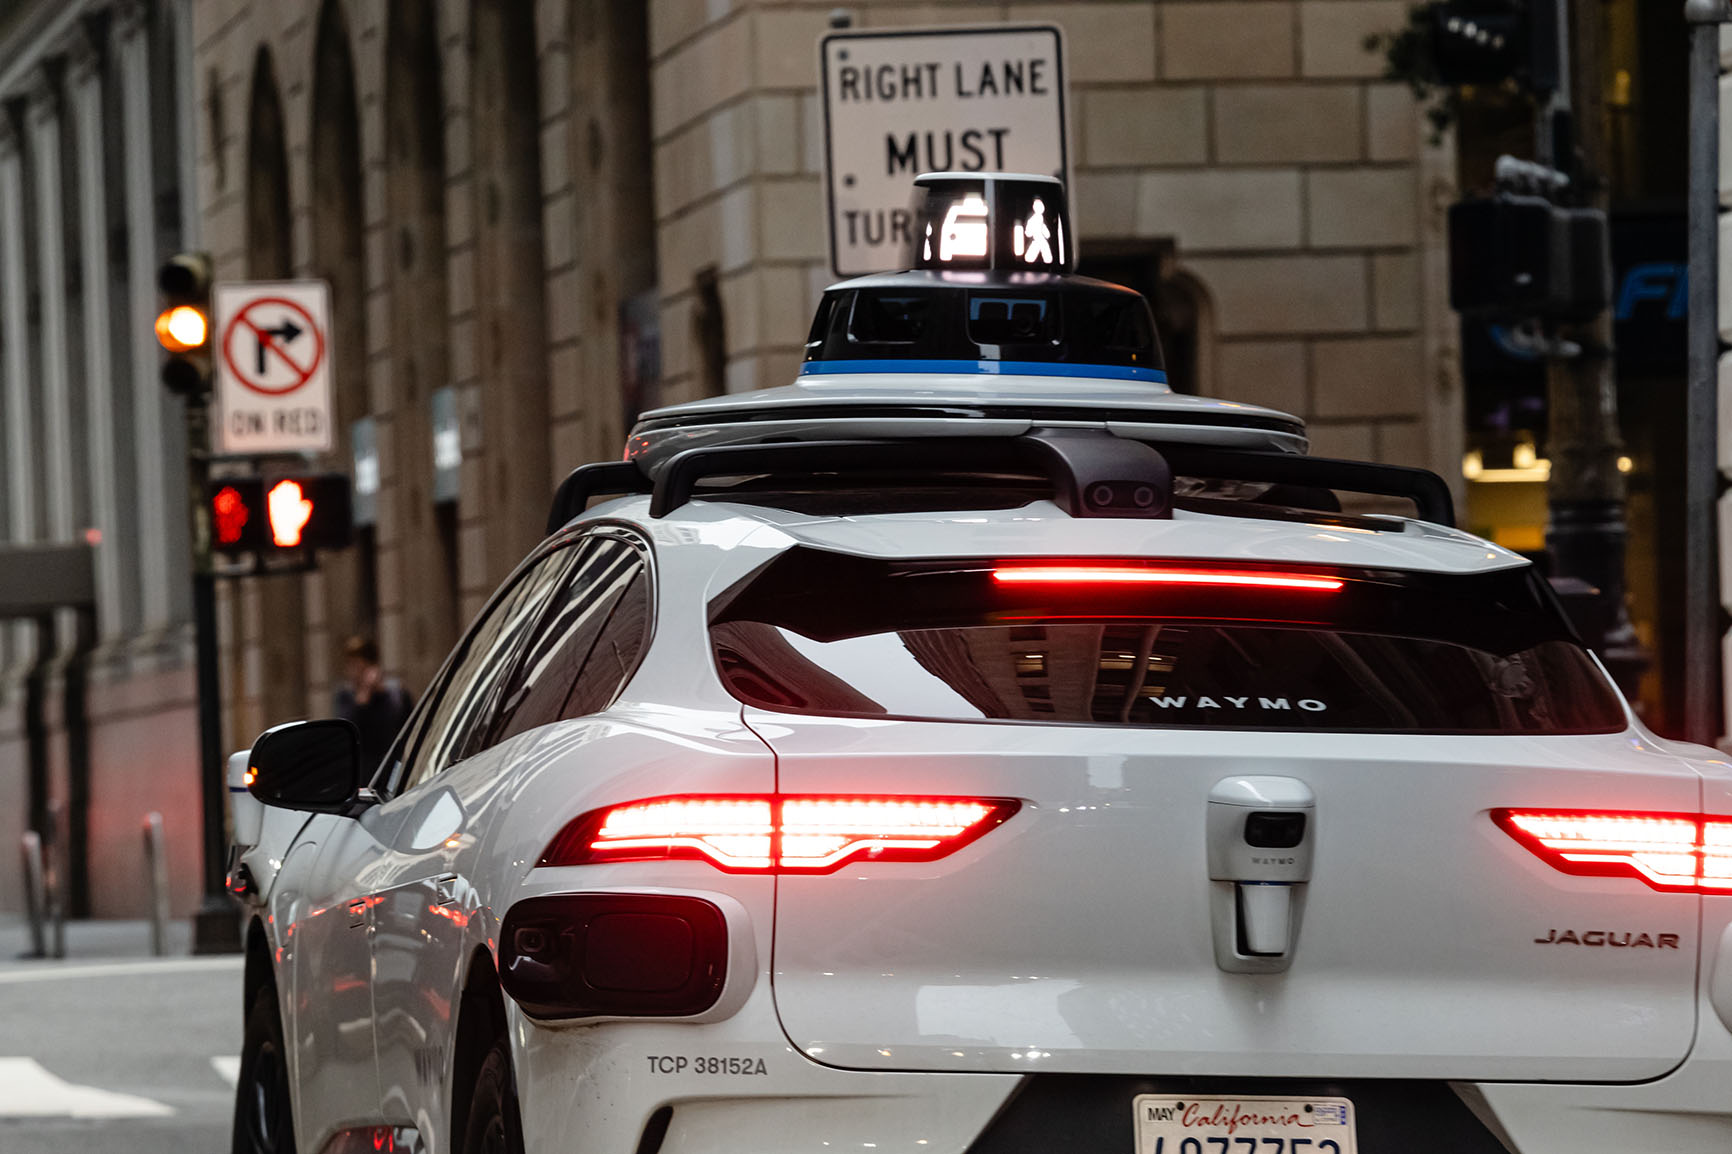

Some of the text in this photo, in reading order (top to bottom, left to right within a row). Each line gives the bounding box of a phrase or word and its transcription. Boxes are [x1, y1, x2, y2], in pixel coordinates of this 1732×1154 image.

[840, 59, 1049, 101] RIGHT LANE
[886, 127, 1011, 176] MUST
[844, 207, 917, 247] TUR
[231, 406, 324, 438] ON RED
[1148, 695, 1328, 712] WAYMO
[1251, 856, 1296, 865] WAYMO
[1533, 929, 1681, 950] JAGUAR
[647, 1055, 768, 1076] TCP 38152A
[1147, 1107, 1177, 1122] MAY
[1181, 1102, 1315, 1135] California
